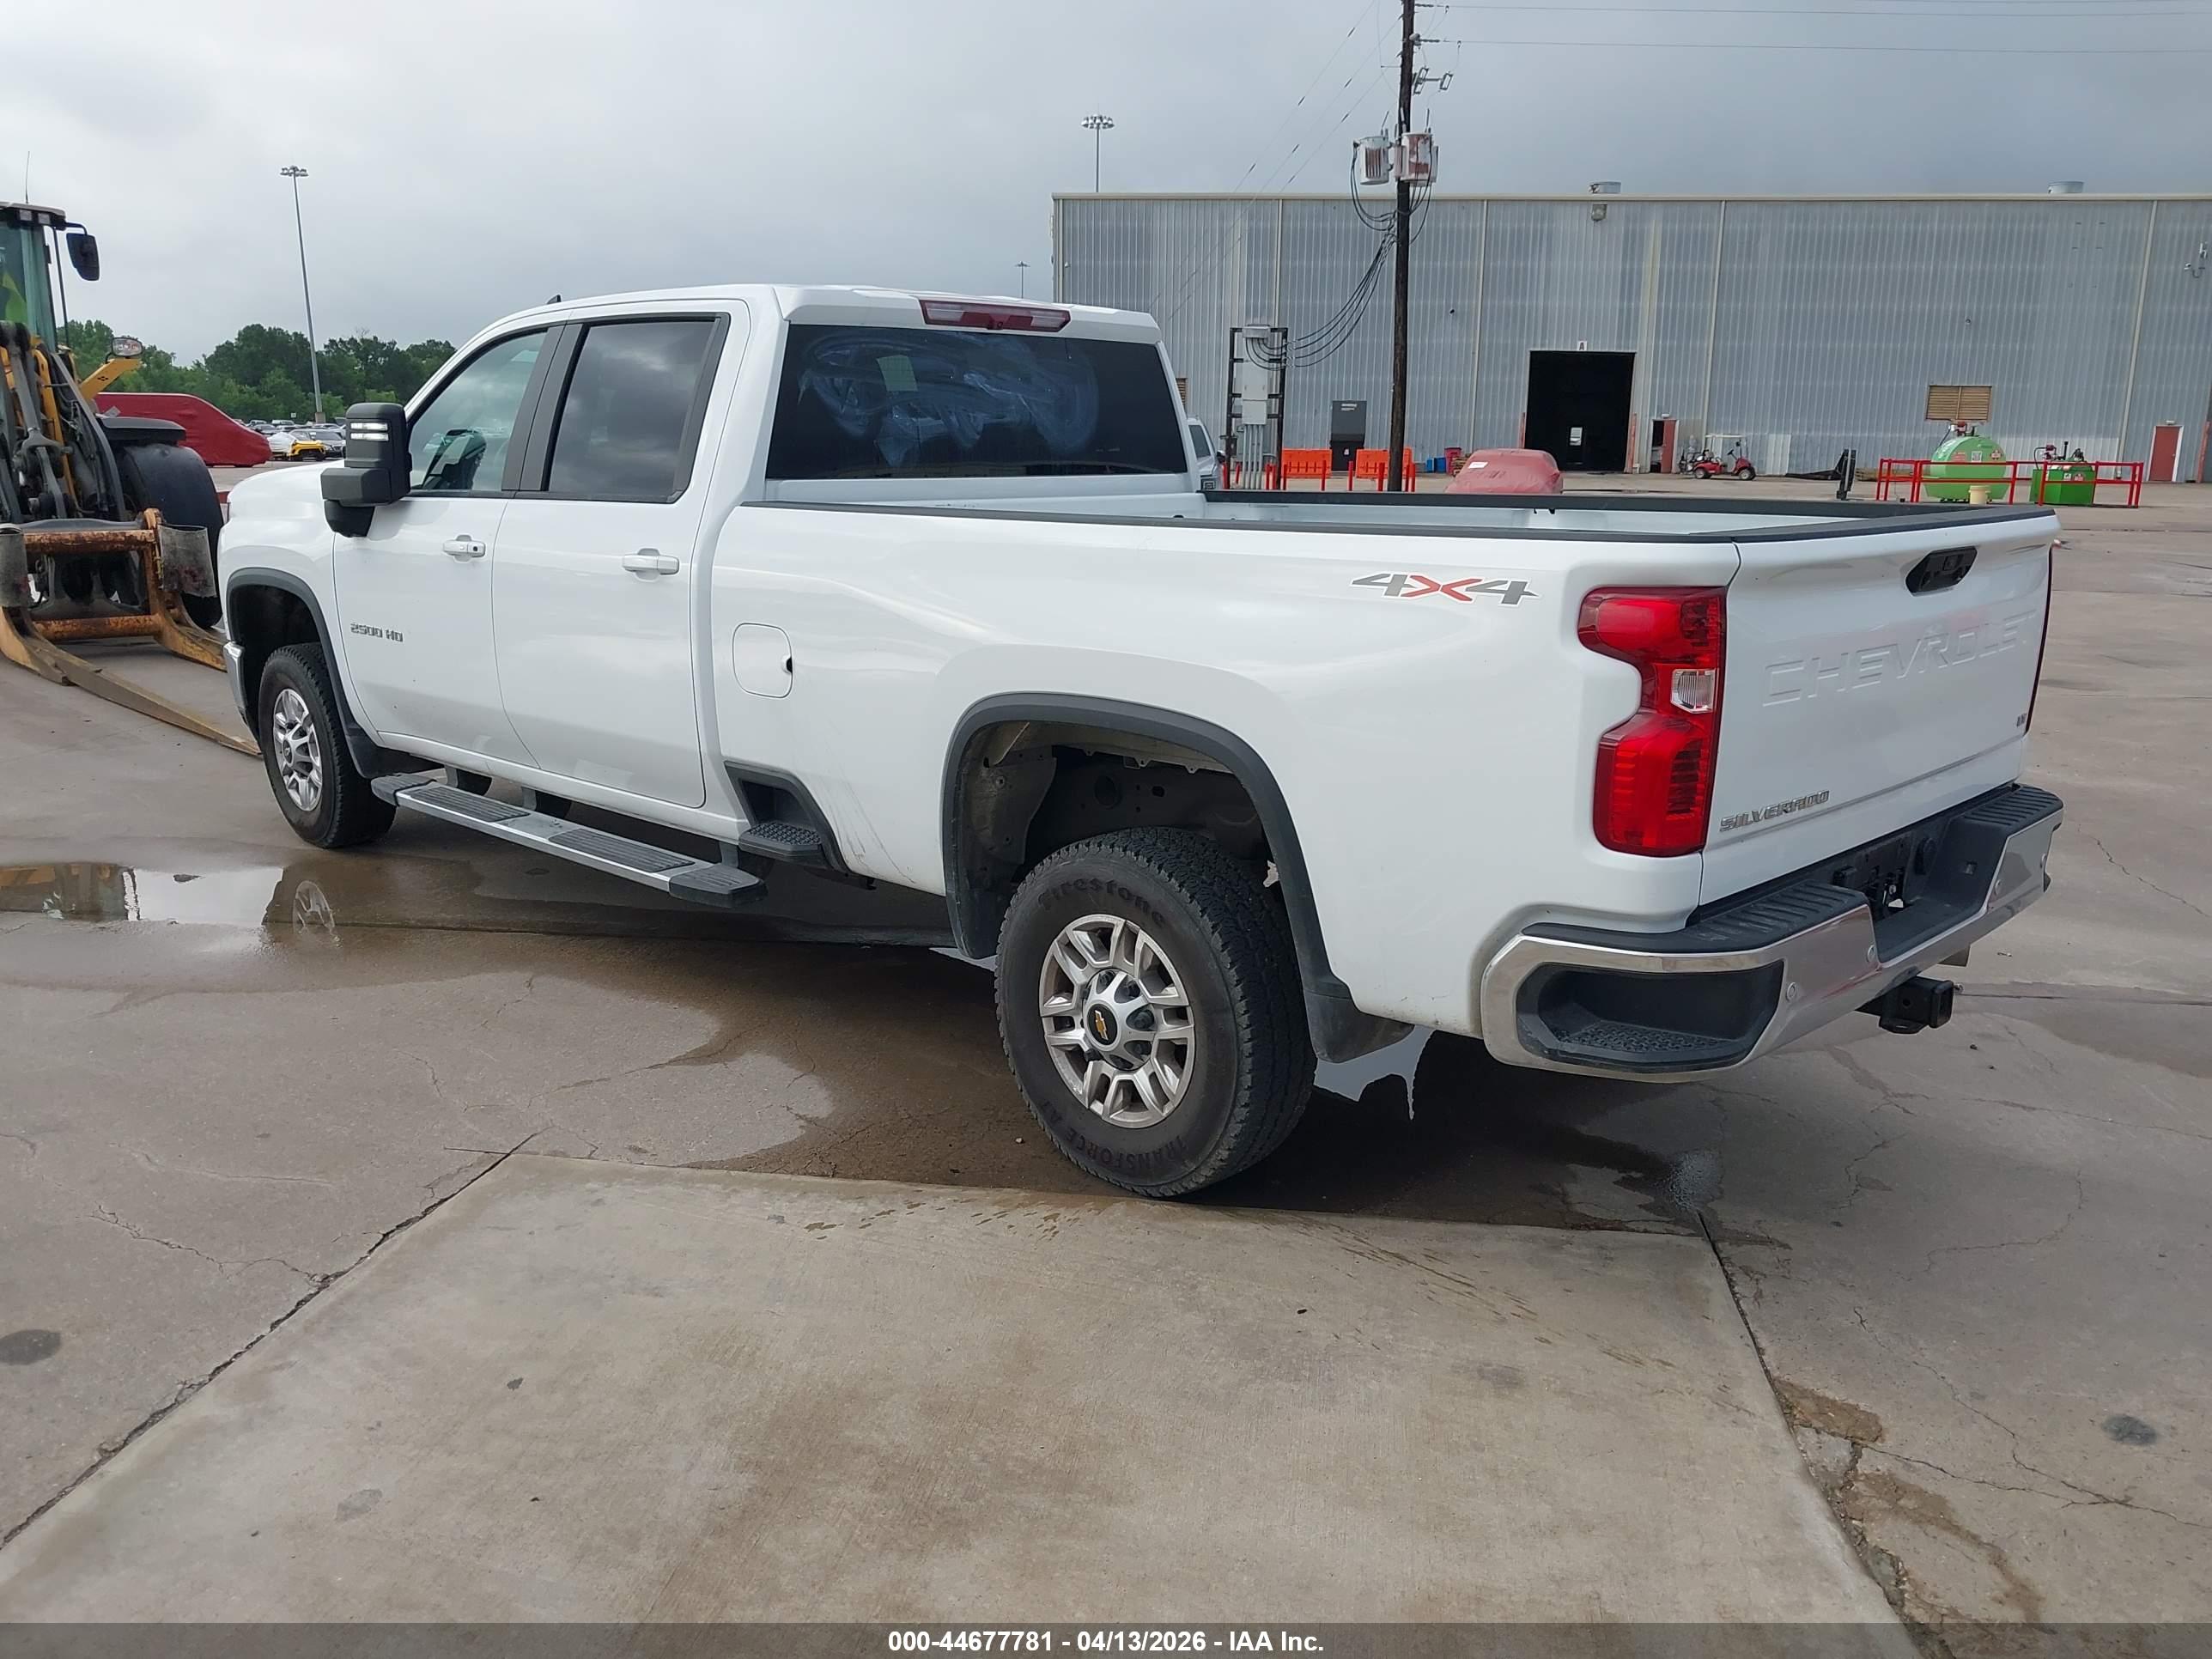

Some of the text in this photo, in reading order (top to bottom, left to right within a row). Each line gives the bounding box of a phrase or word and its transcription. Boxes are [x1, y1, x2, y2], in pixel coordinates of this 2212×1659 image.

[349, 622, 404, 642] 2500 HD
[1762, 608, 2038, 708] CHEVROLET
[1719, 789, 1831, 832] SILVERADO
